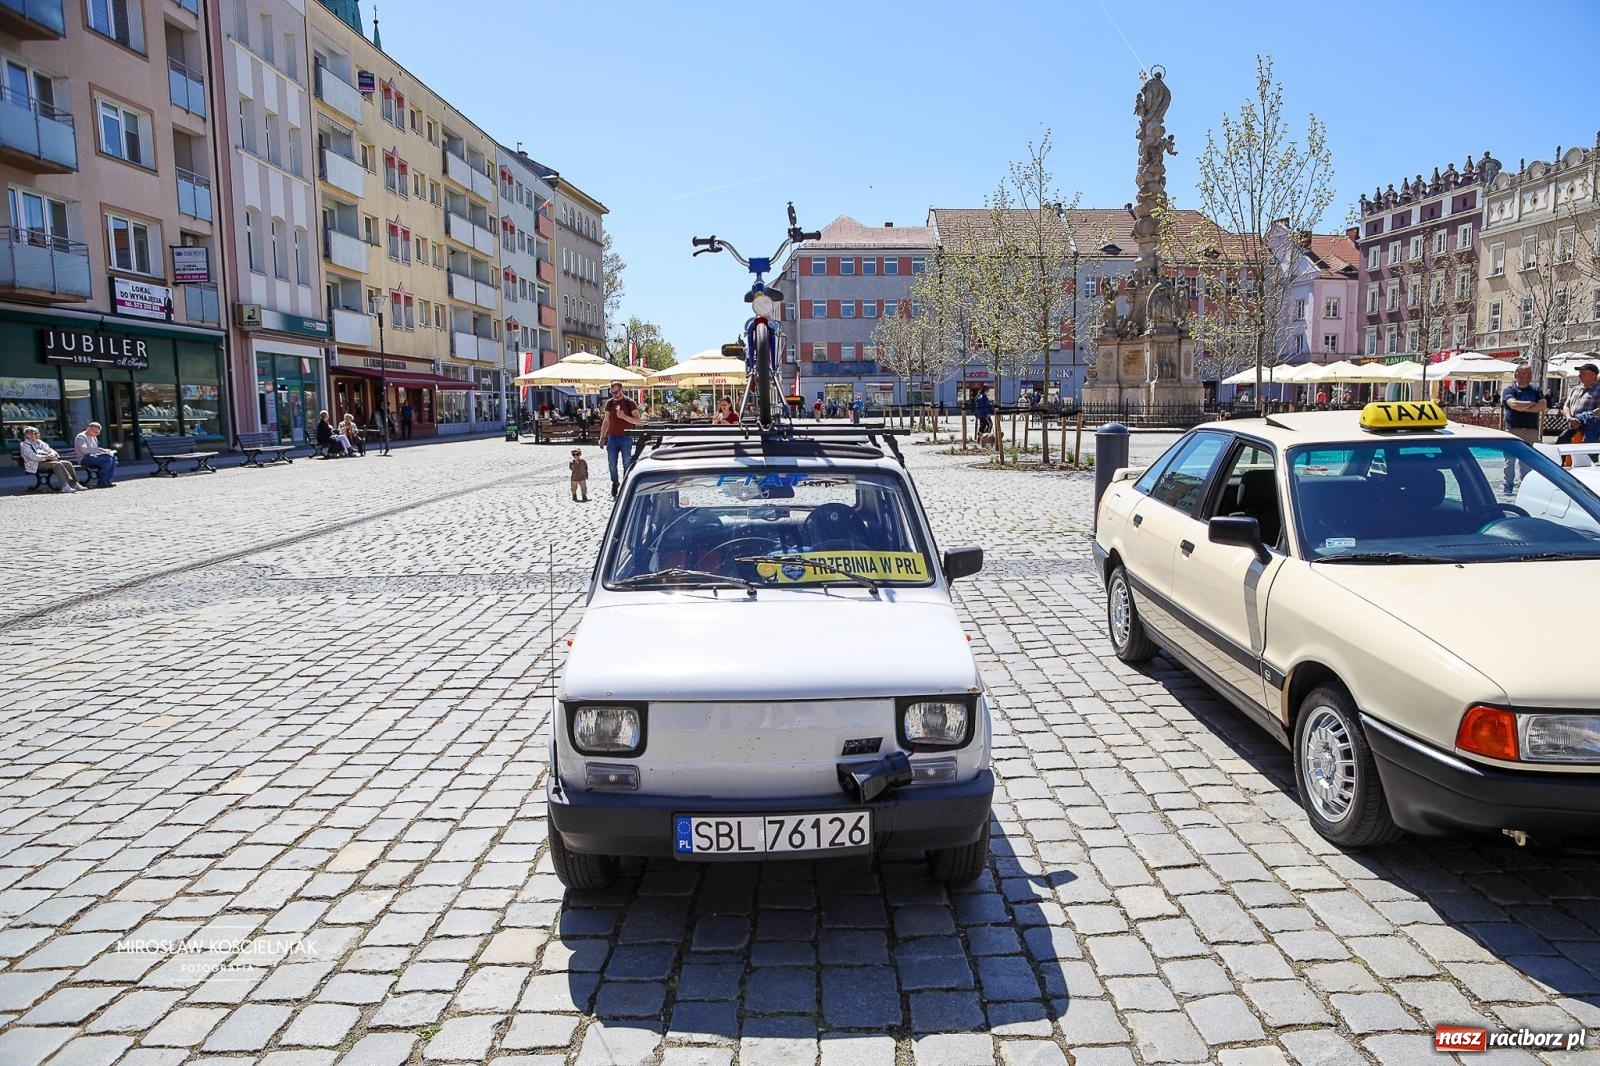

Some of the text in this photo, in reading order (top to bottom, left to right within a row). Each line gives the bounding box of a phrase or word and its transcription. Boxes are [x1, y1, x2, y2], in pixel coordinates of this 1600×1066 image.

[131, 285, 151, 295] LOKAL
[47, 331, 148, 358] JUBILER
[73, 355, 92, 363] 1989
[1377, 403, 1439, 422] TAXI
[716, 471, 809, 487] FIAT
[809, 556, 878, 575] TRZEBINIA
[879, 557, 892, 574] W
[896, 557, 922, 575] PRL
[694, 815, 866, 852] SBL 76126
[679, 840, 691, 849] PL
